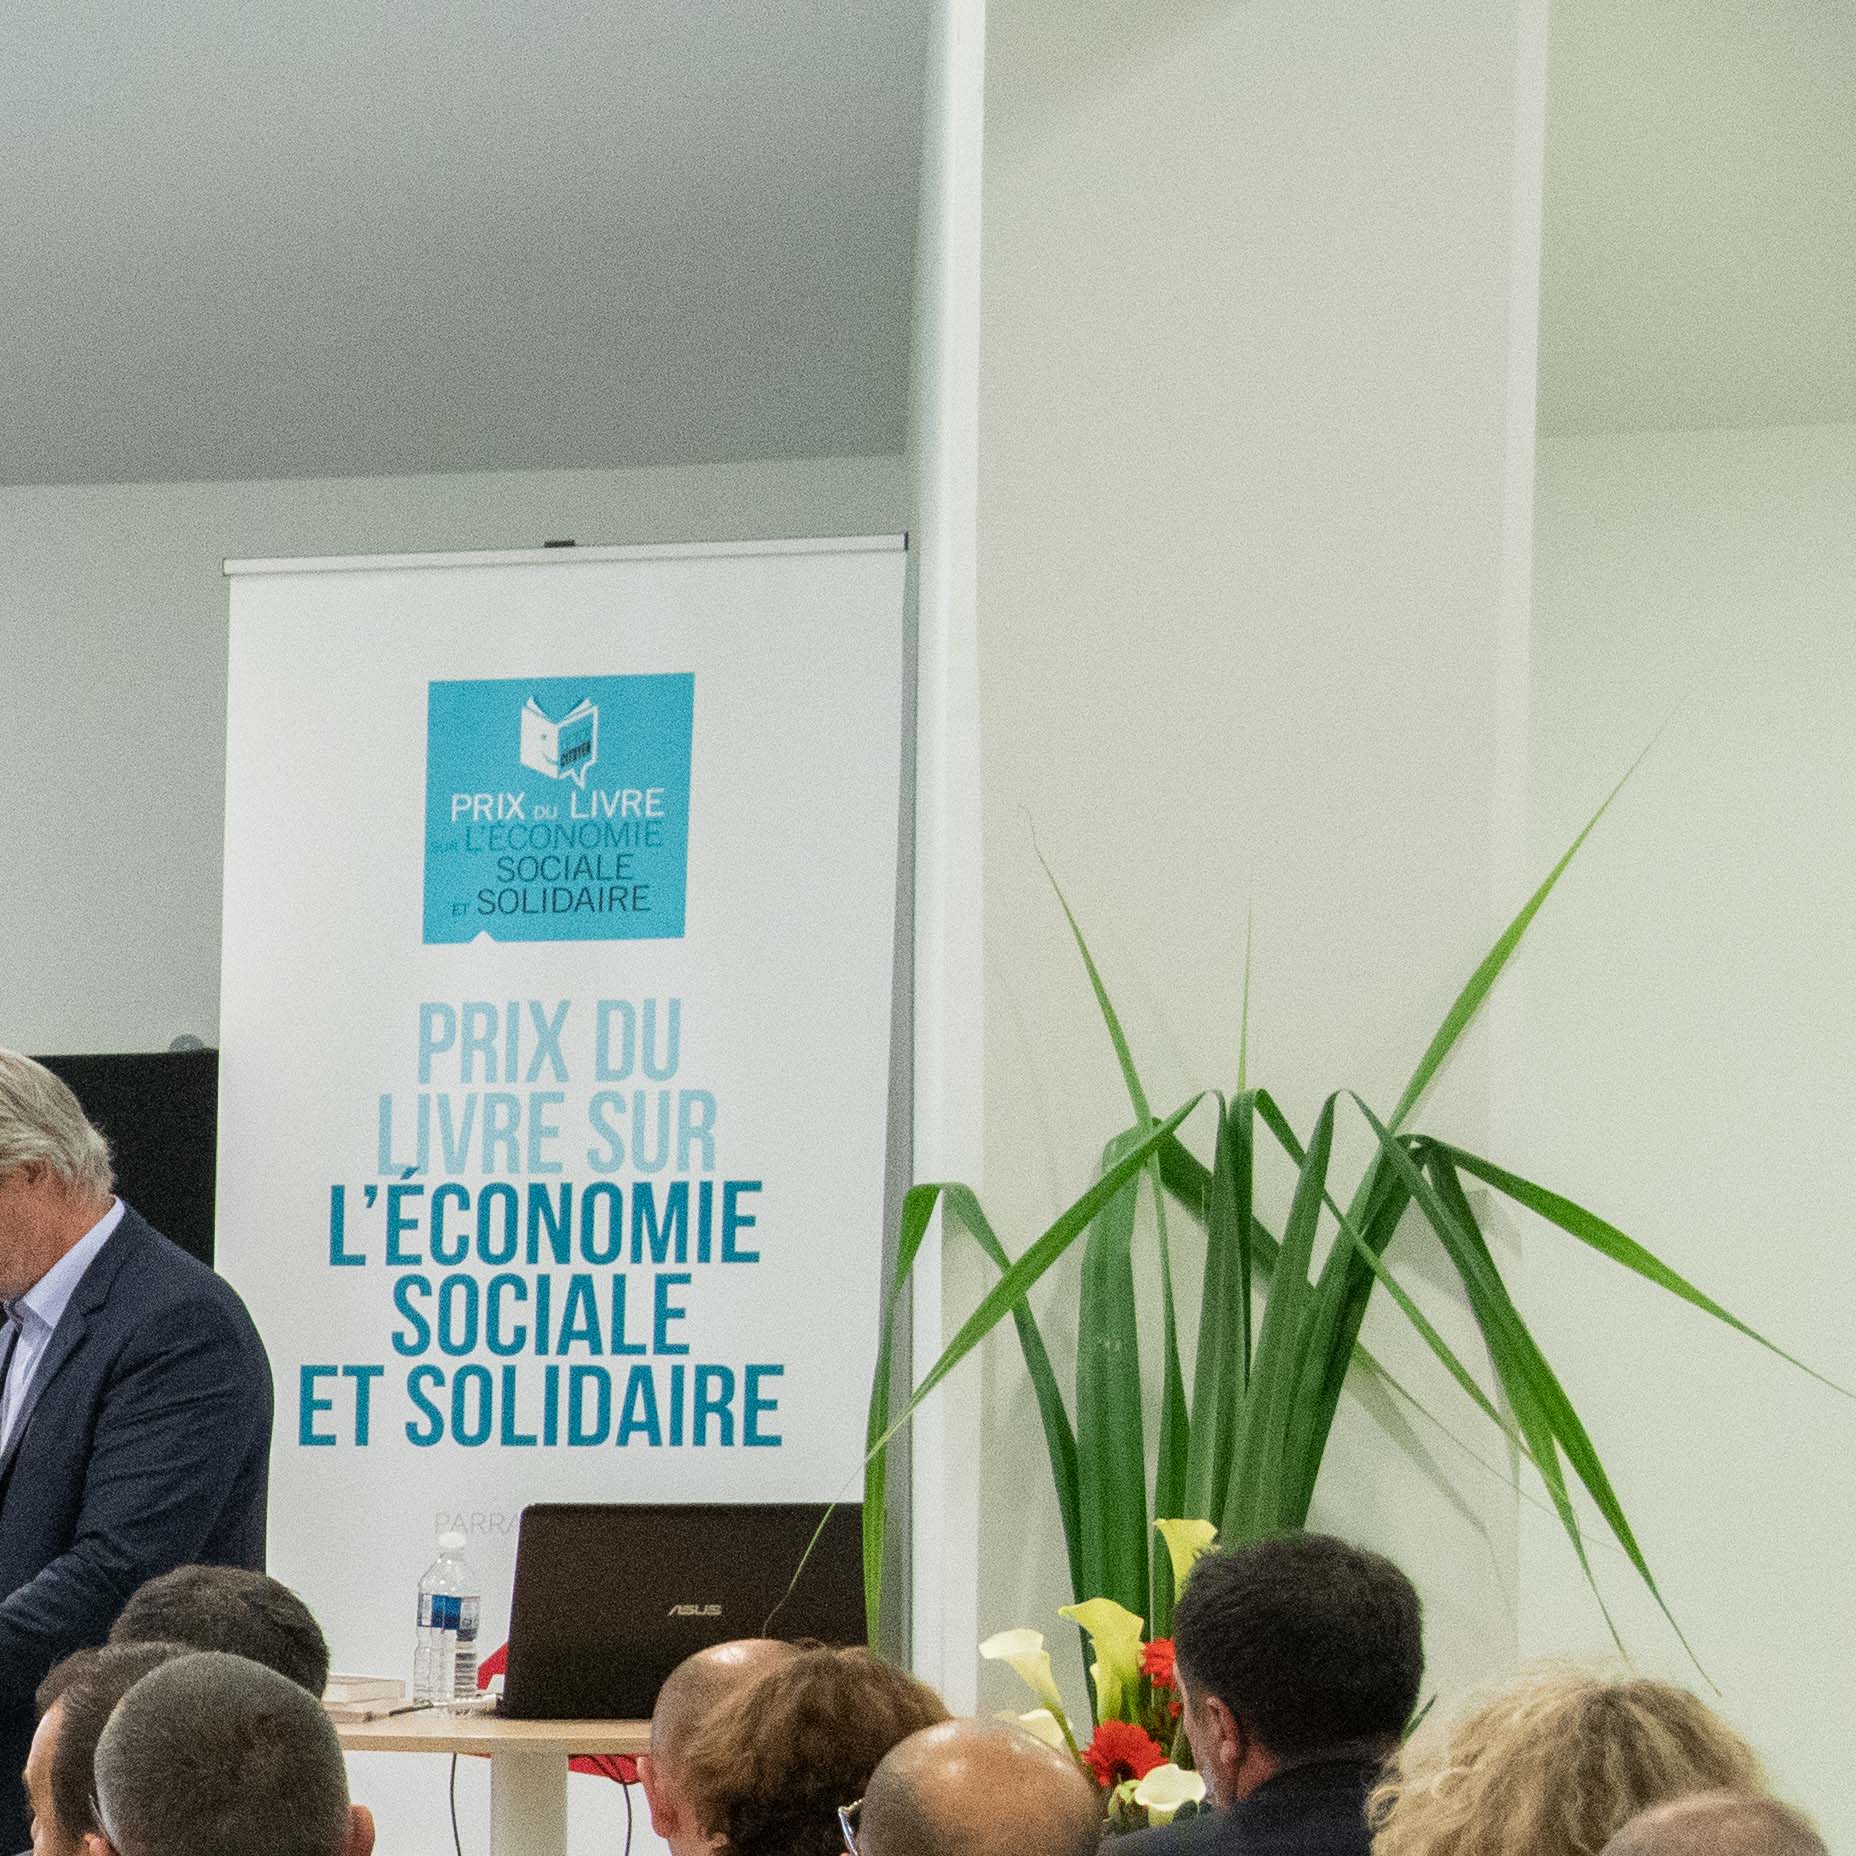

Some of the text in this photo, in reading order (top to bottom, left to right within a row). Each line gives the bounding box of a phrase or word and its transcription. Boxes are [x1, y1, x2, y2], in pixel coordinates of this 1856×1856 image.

[451, 787, 666, 823] PRIX DU LIVRE
[465, 818, 665, 852] L'ÉCONOMIE
[496, 853, 635, 884] SOCIALE
[451, 884, 651, 917] ET SOLIDAIRE
[418, 998, 682, 1084] PRIX DU
[376, 1090, 717, 1176] LIVRE SUR
[329, 1167, 763, 1266] L'ÉCONOMIE
[391, 1272, 692, 1357] SOCIALE
[298, 1363, 785, 1448] ET SOLIDAIRE
[667, 1604, 722, 1616] ASUS
